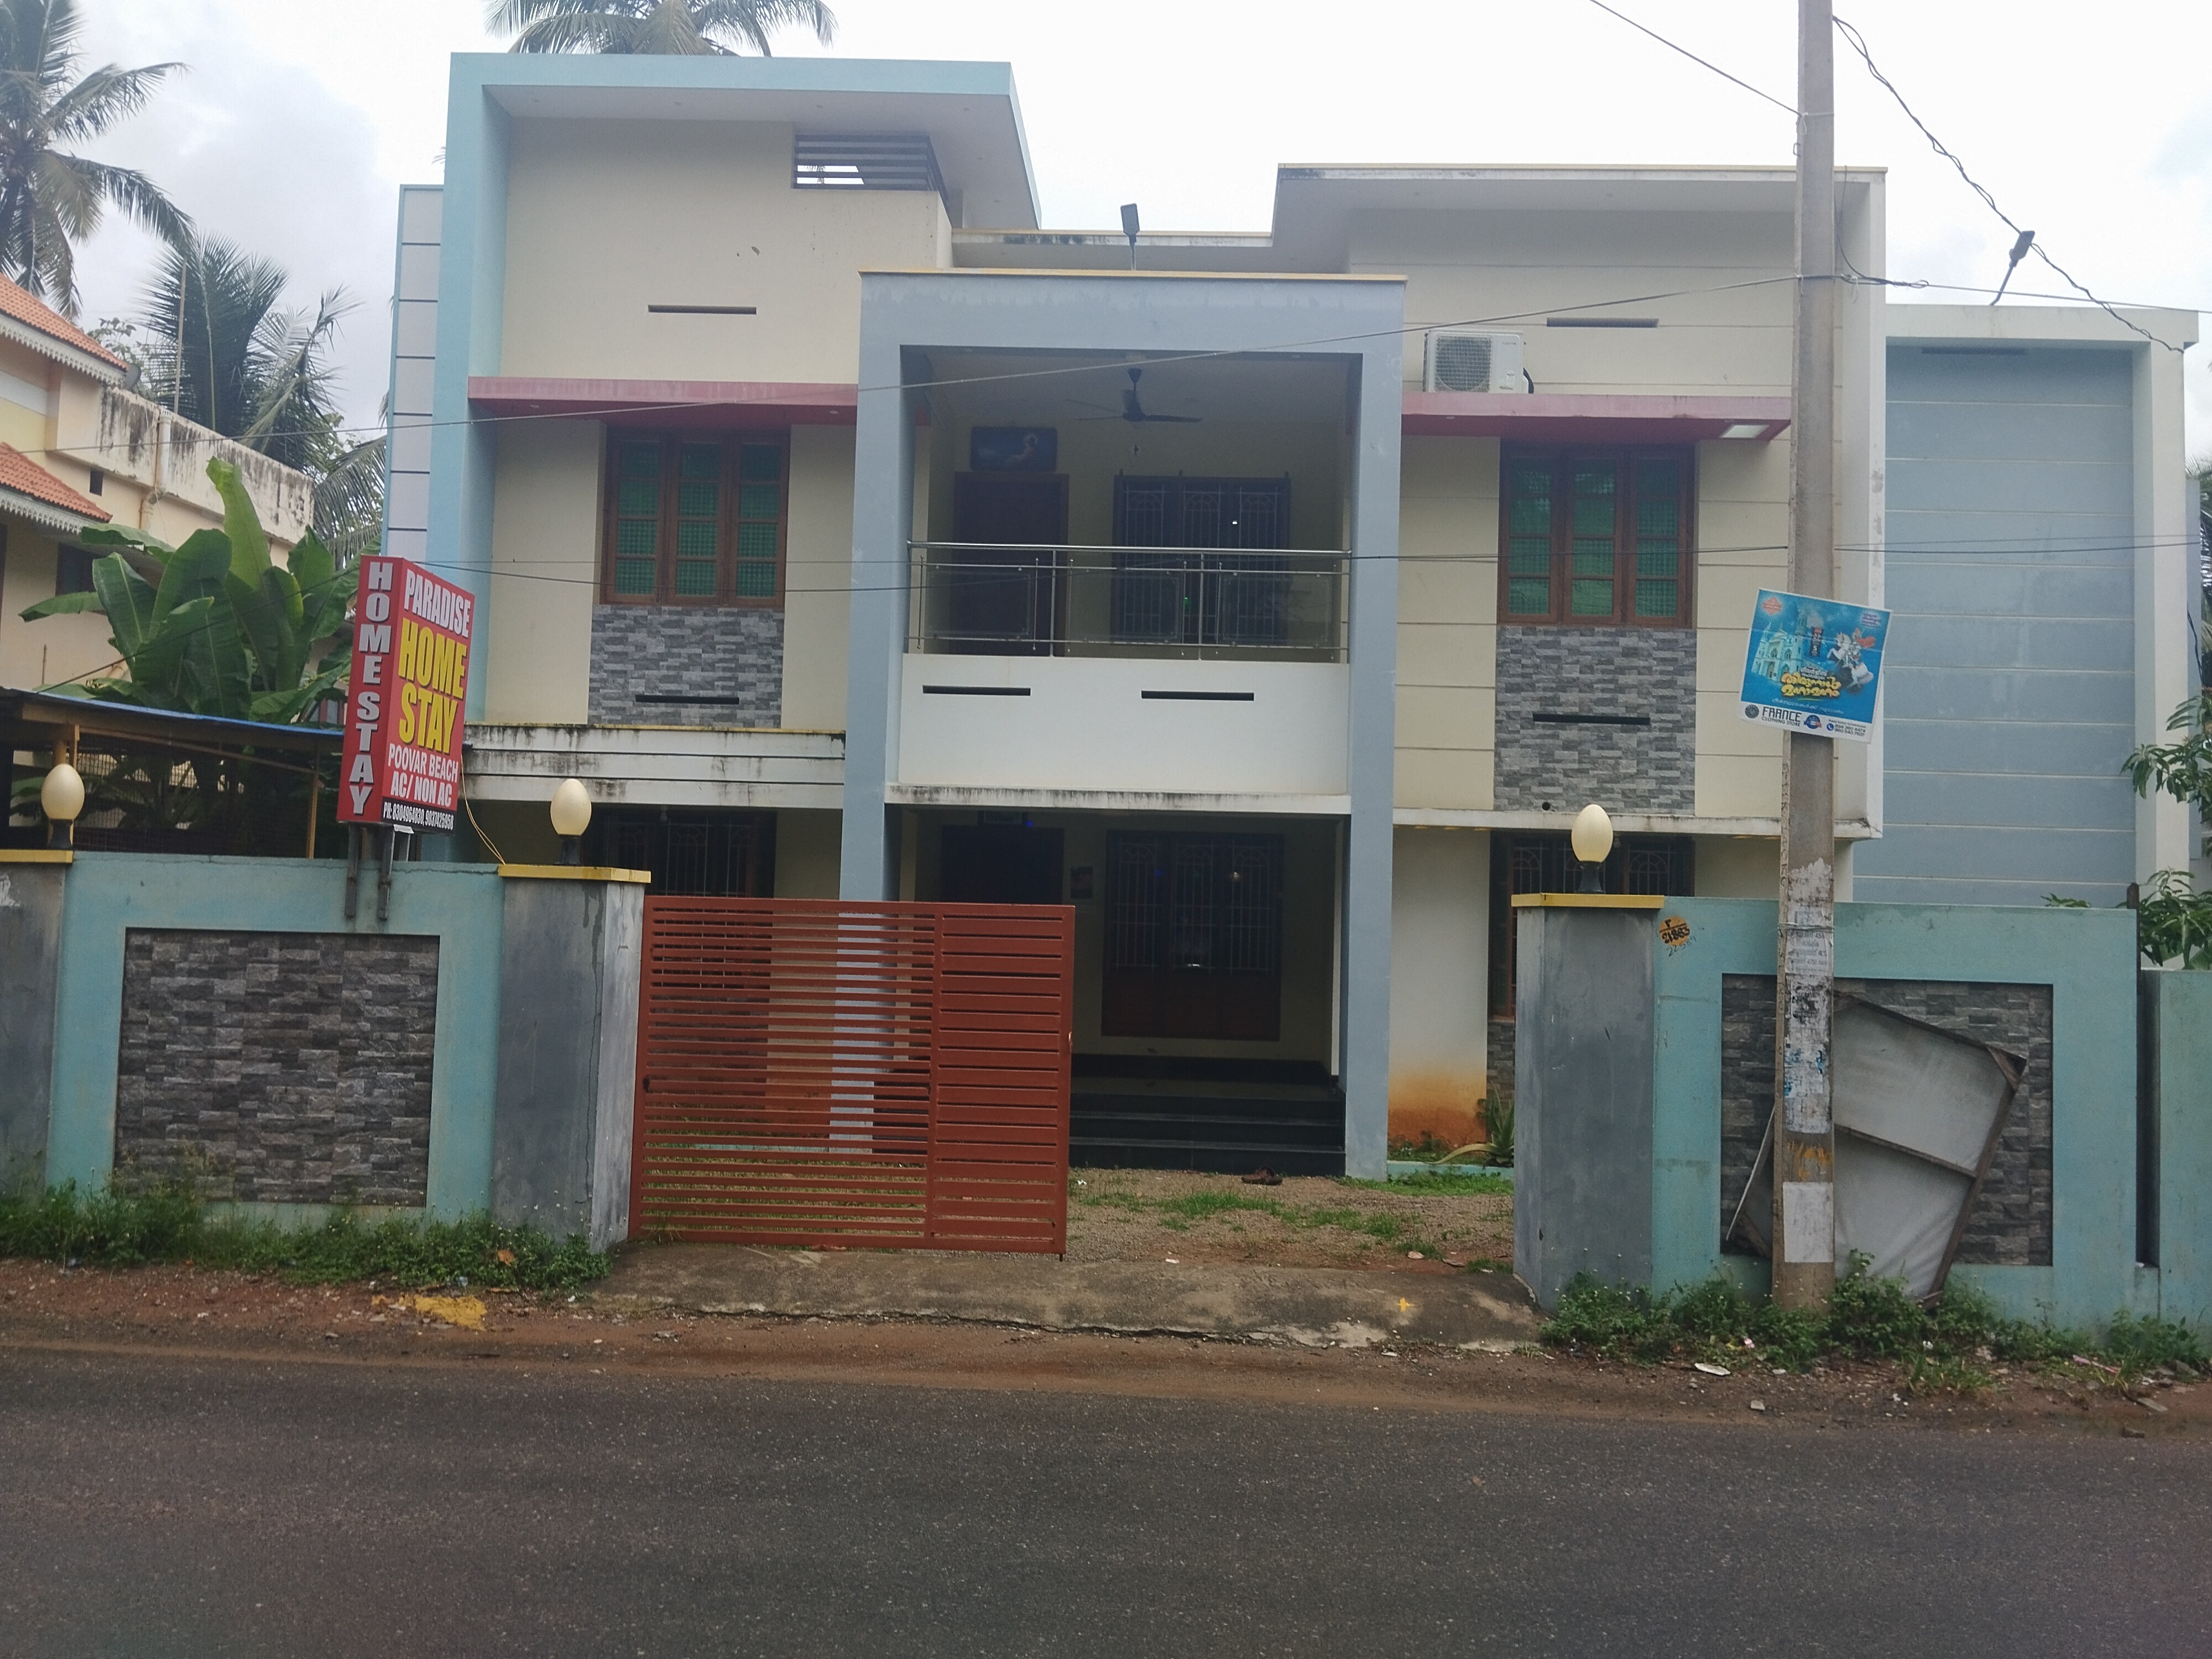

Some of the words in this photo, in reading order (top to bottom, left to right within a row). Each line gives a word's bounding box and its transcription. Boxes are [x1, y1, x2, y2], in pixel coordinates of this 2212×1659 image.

[404, 568, 471, 638] PARADISE
[398, 617, 467, 700] HOME
[399, 682, 458, 754] STAY
[1761, 717, 1786, 726] CLOTHING
[1762, 706, 1802, 722] FRANCE
[388, 743, 427, 775] POOVAR
[428, 754, 459, 784] BEACH
[390, 771, 414, 800] AC/
[414, 777, 437, 804] NON
[437, 782, 452, 808] AC
[383, 802, 392, 820] PH:
